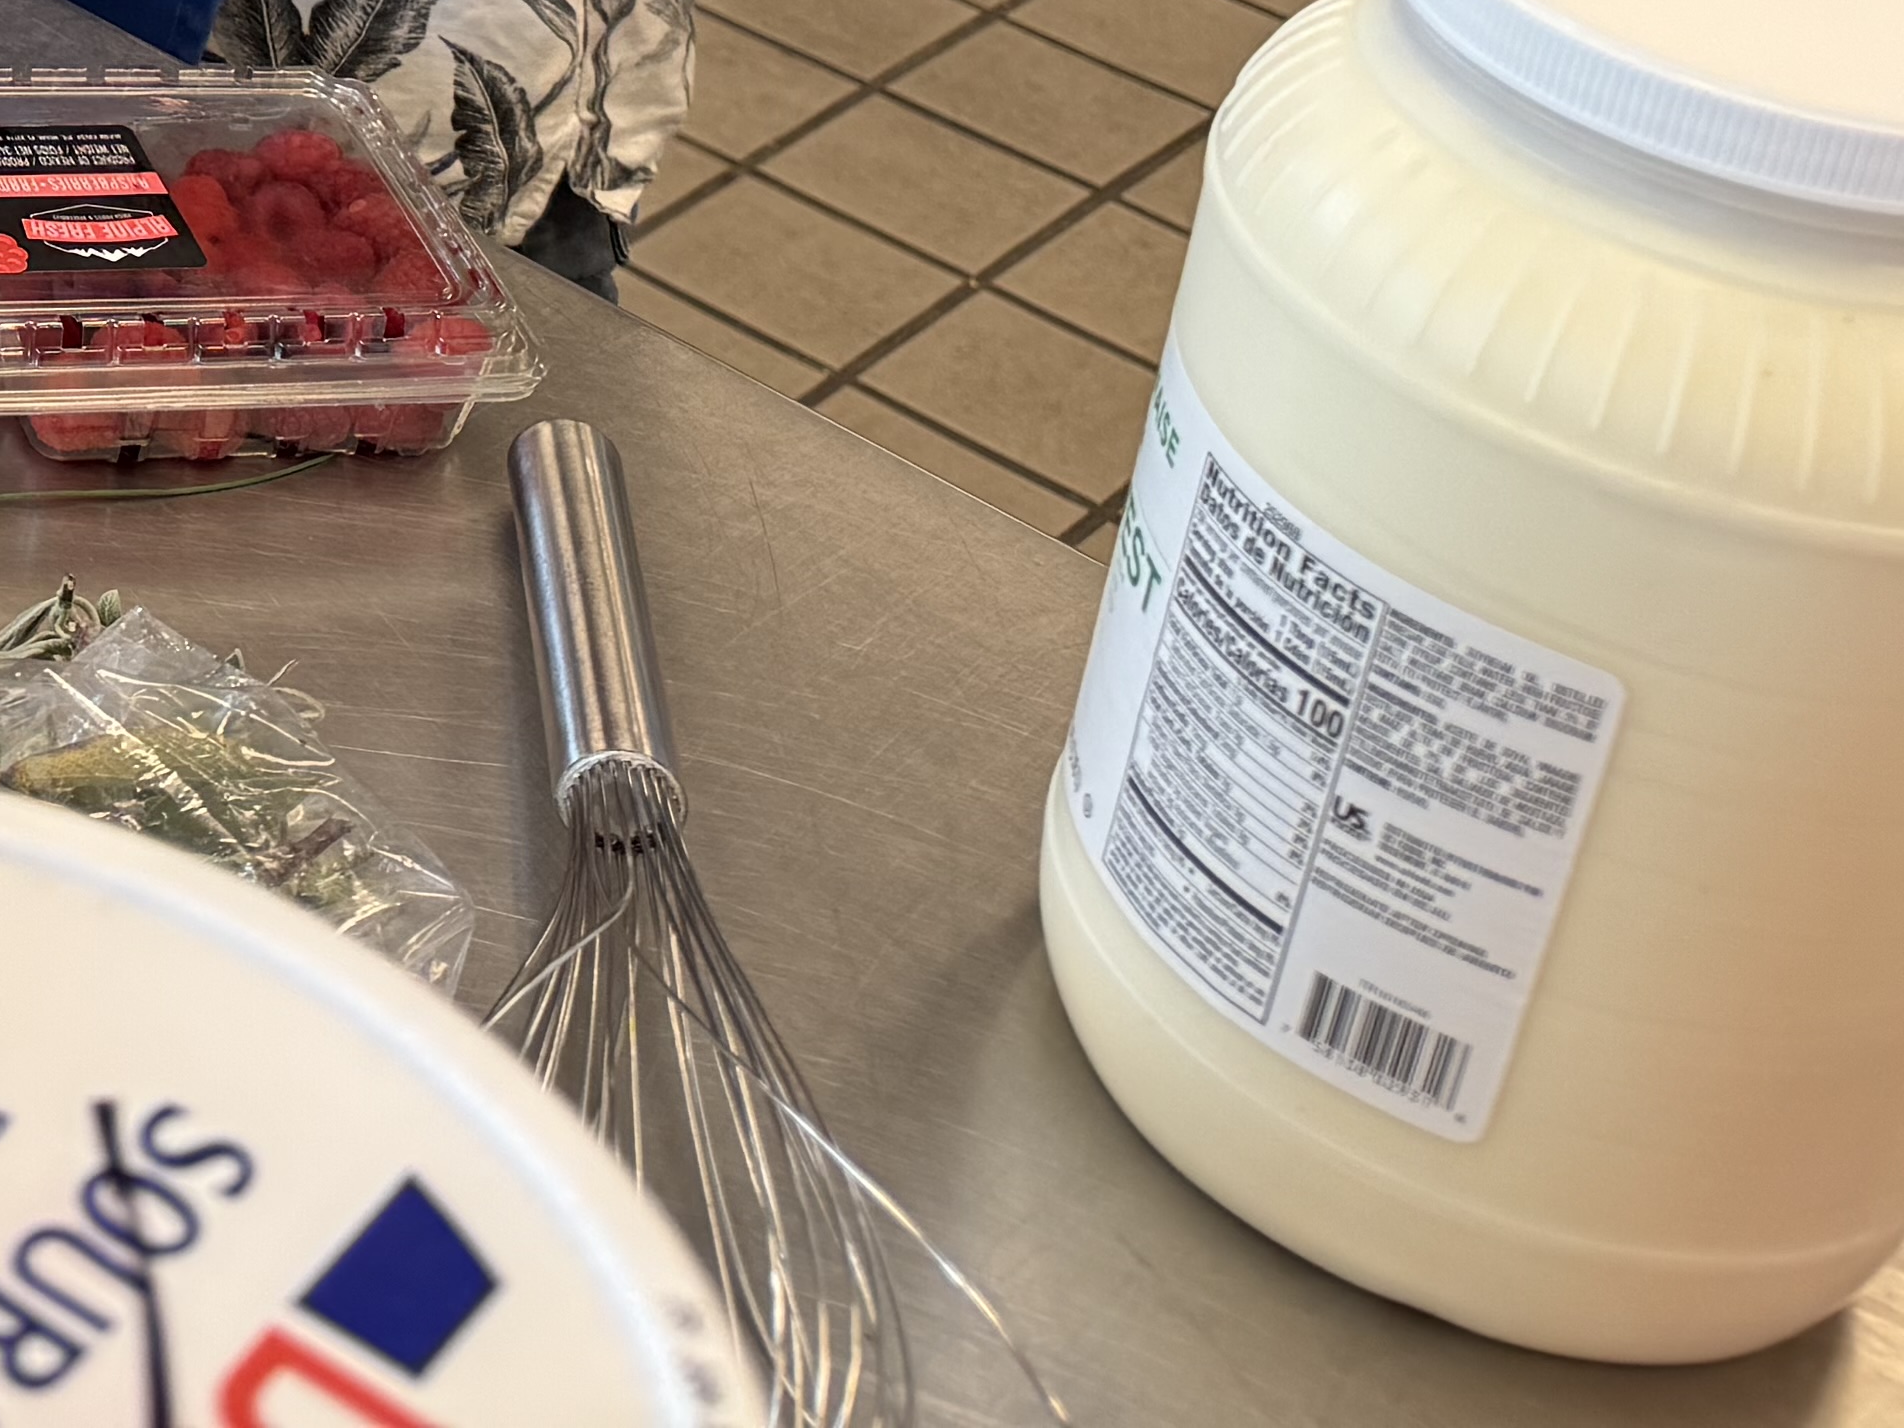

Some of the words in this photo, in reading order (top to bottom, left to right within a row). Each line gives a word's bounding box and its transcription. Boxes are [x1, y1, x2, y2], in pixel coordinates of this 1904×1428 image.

[45, 175, 151, 191] RASPBERRIES
[27, 219, 97, 241] FRESH
[95, 216, 174, 239] ALPINE
[1206, 458, 1295, 565] Nutrition
[1300, 539, 1378, 621] Facts
[1296, 687, 1345, 741] 100
